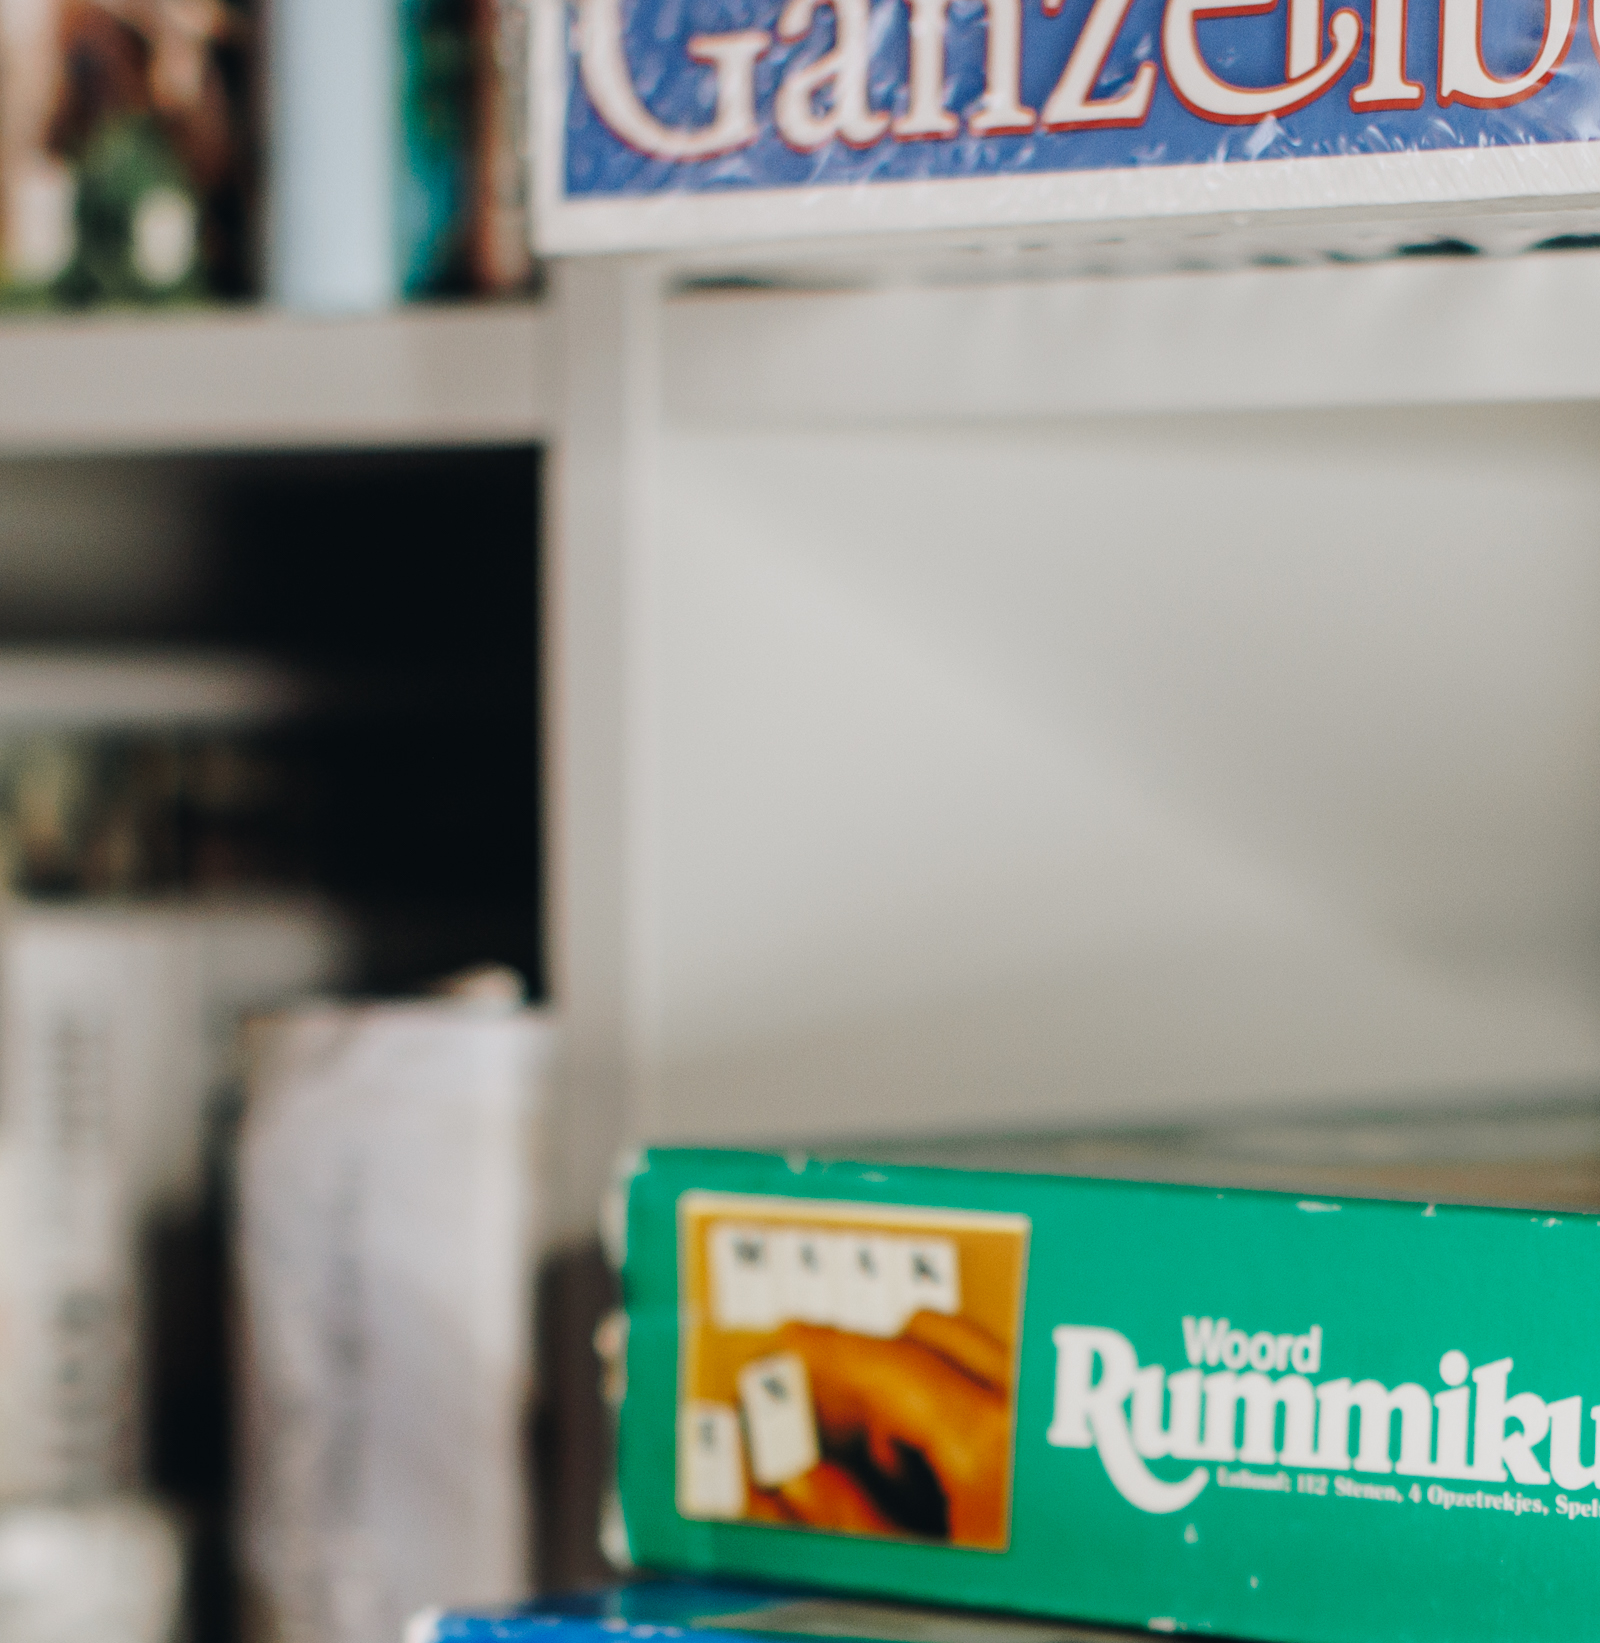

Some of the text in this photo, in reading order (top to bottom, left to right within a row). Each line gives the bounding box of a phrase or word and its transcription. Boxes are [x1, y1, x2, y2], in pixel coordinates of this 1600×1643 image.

[1182, 1316, 1322, 1375] Woord
[1408, 1483, 1422, 1504] 4
[1427, 1484, 1550, 1516] Opzetrekjes,
